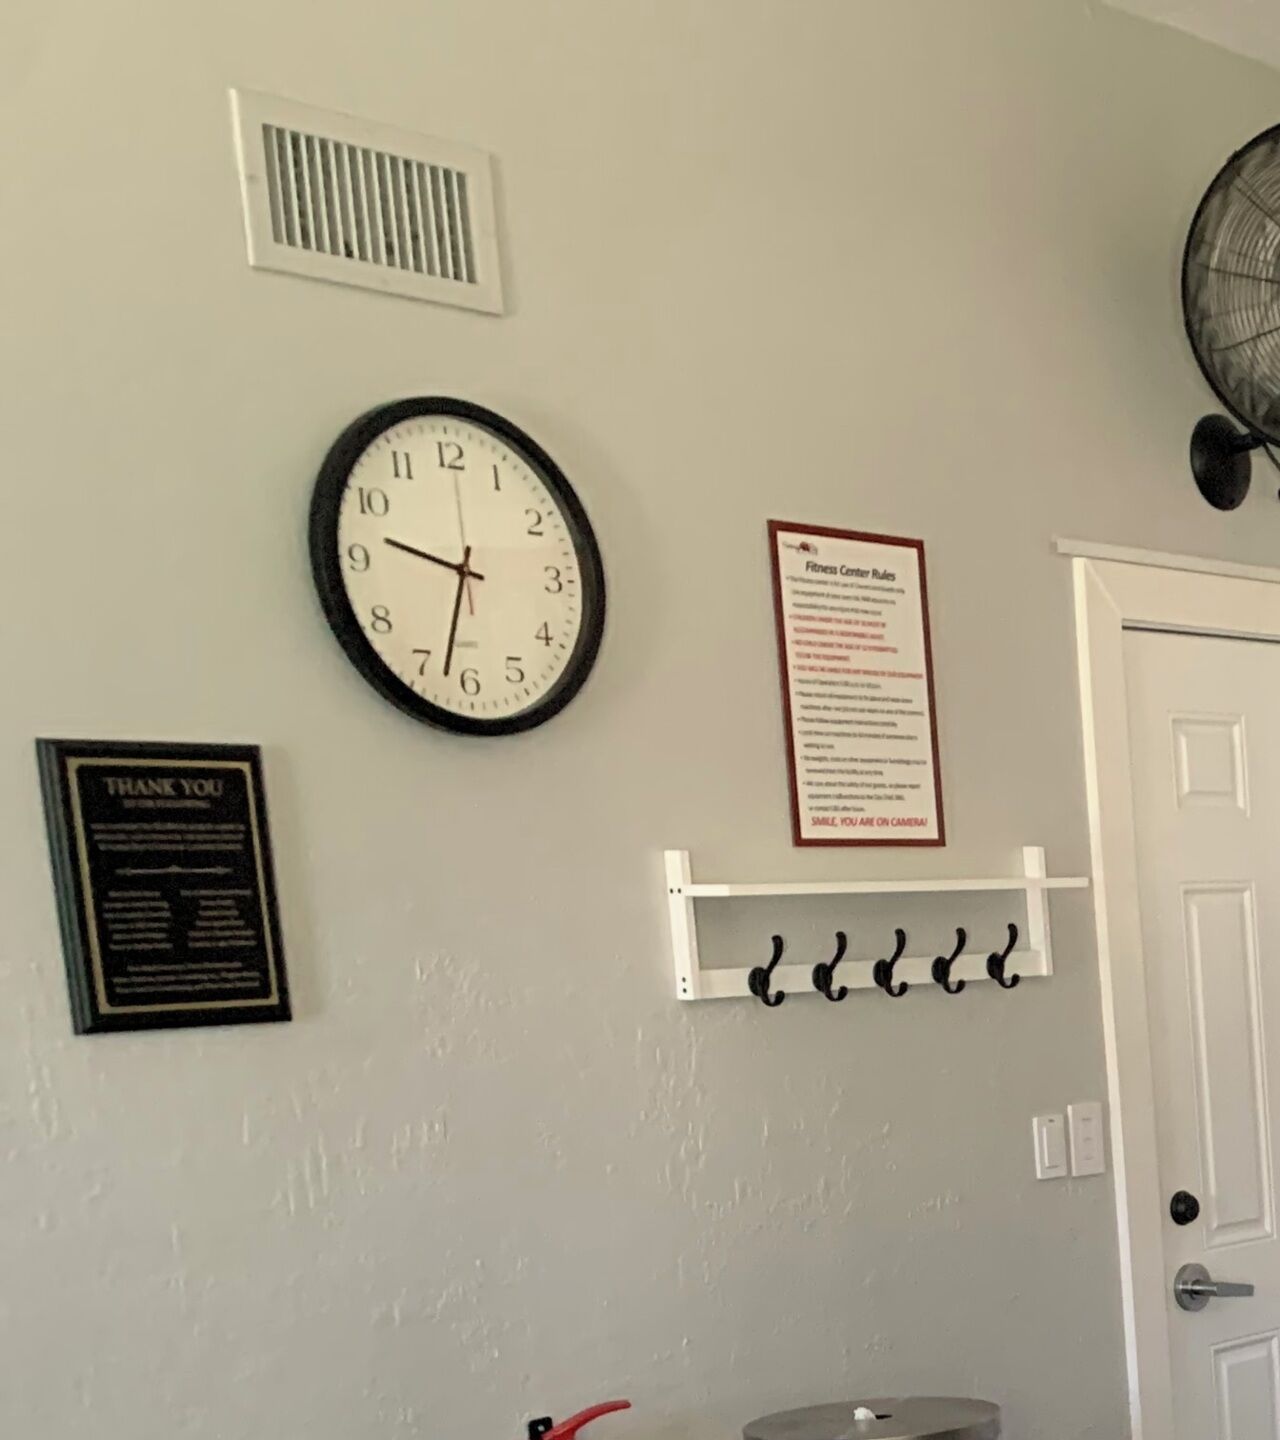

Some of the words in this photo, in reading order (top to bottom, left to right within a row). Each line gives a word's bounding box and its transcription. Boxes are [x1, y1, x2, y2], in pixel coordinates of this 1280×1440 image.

[391, 450, 414, 480] 11
[437, 441, 465, 471] 12
[492, 464, 501, 491] 1
[358, 487, 389, 517] 10
[524, 508, 544, 536] 2
[348, 543, 370, 573] 9
[806, 561, 837, 575] Fitness
[840, 564, 870, 578] Center
[872, 568, 896, 581] Rules
[544, 566, 563, 594] 3
[370, 605, 393, 634] 8
[535, 621, 554, 647] 4
[412, 649, 432, 676] 7
[505, 656, 525, 683] 5
[460, 668, 481, 696] 6
[103, 777, 176, 796] THANK
[180, 779, 222, 797] YOU
[840, 816, 858, 826] YOU
[859, 817, 875, 826] ARE
[876, 817, 890, 826] ON
[891, 817, 928, 827] CAMERA!
